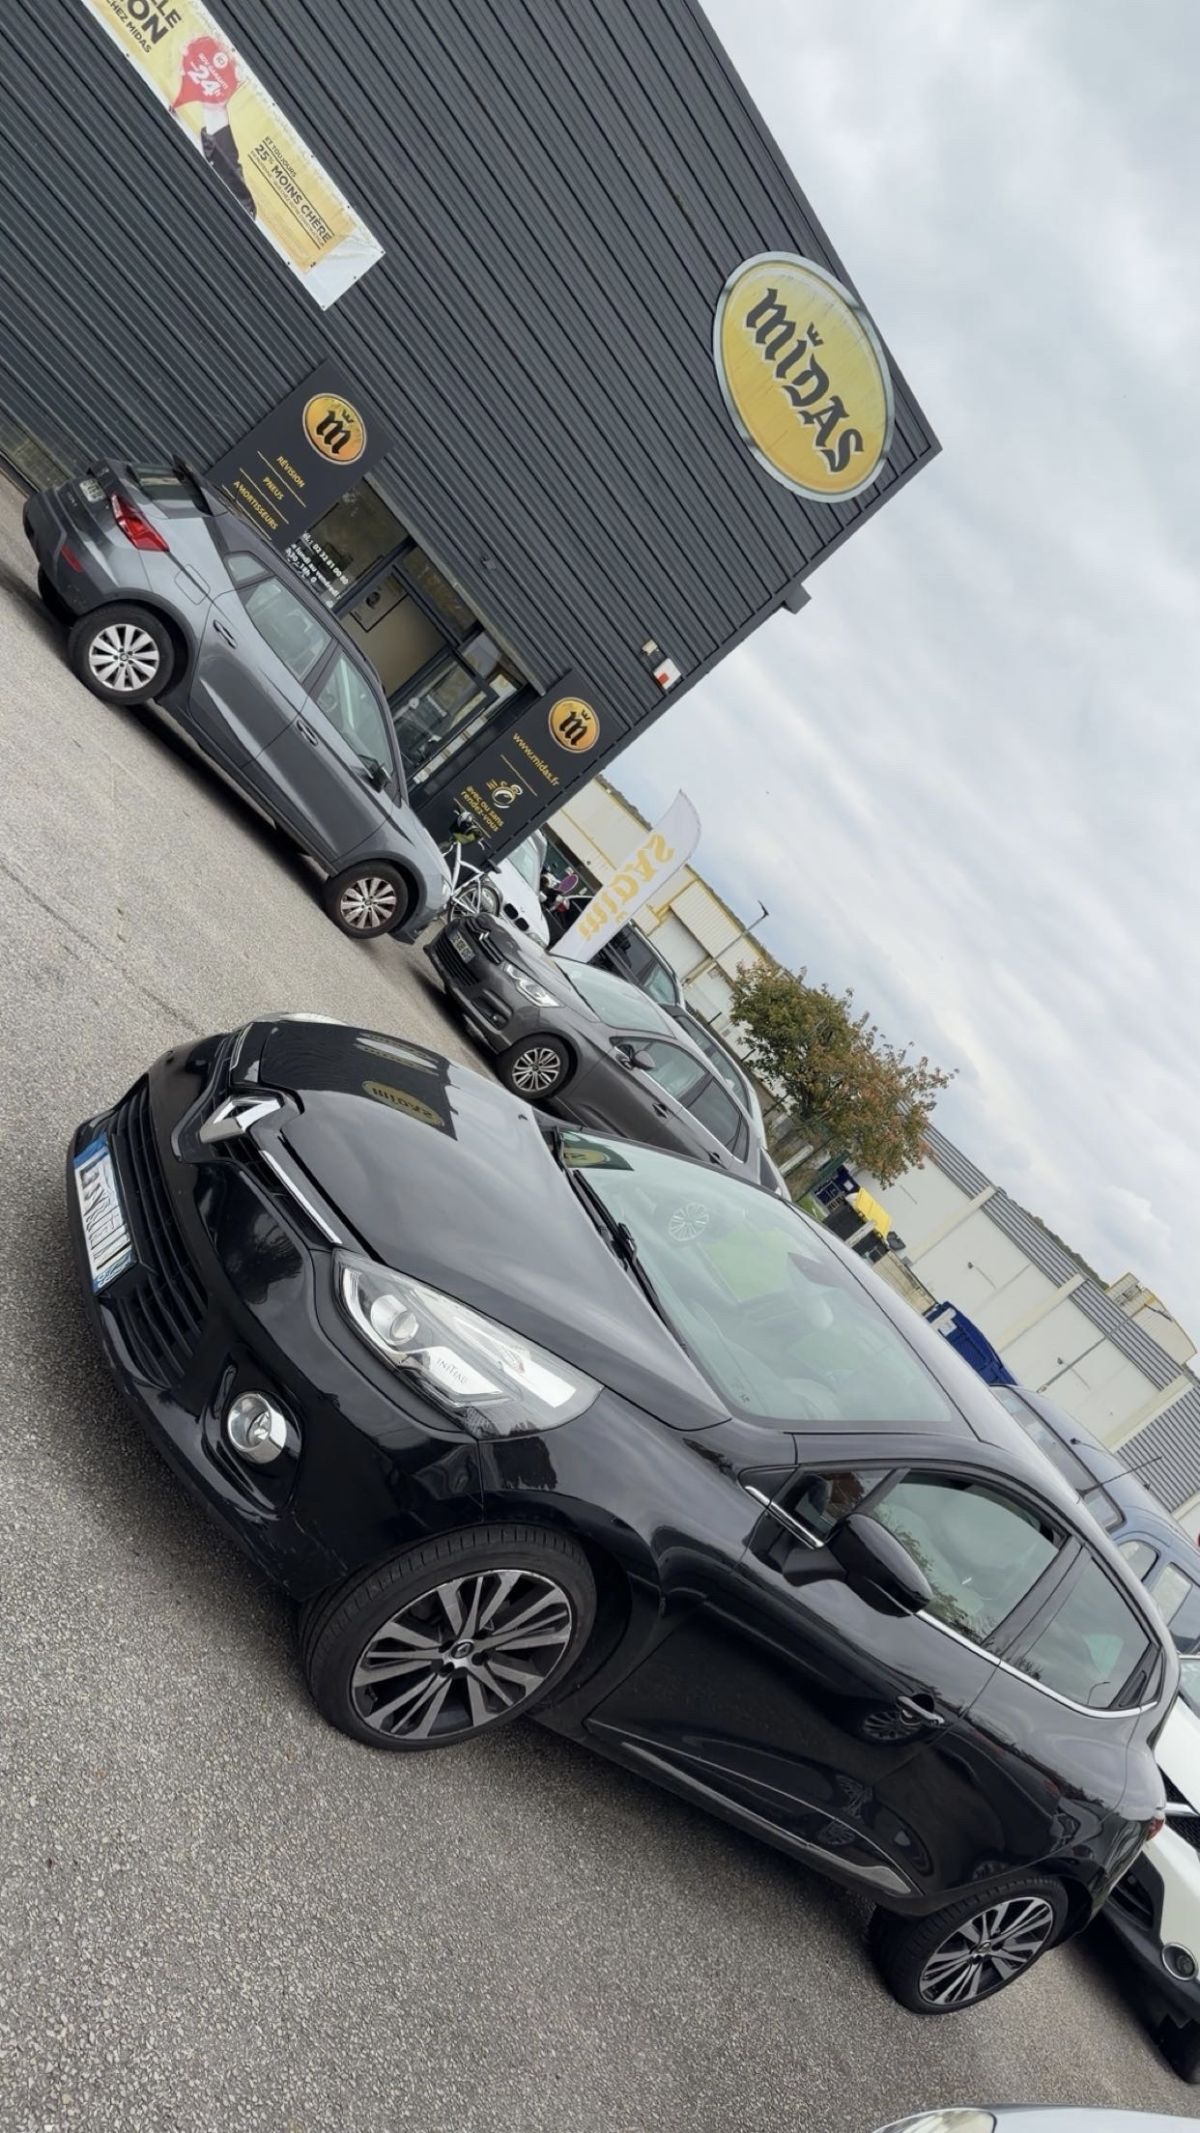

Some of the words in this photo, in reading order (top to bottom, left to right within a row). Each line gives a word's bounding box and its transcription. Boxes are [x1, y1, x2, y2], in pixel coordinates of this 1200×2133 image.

[150, 0, 182, 29] LE
[126, 22, 152, 53] MIDAS
[265, 136, 273, 145] ET
[271, 144, 297, 178] TOUJOURS
[271, 165, 303, 205] MOINS
[300, 204, 333, 243] CHÈRE
[263, 476, 284, 500] PNEUS
[276, 455, 305, 488] RÉVISION
[233, 480, 279, 530] AMORTISSEURS
[308, 563, 317, 572] au
[512, 732, 560, 786] www.midas.fr
[460, 790, 499, 832] rendez-vous
[466, 785, 482, 803] avec
[480, 800, 491, 812] ou
[490, 810, 505, 828] sans
